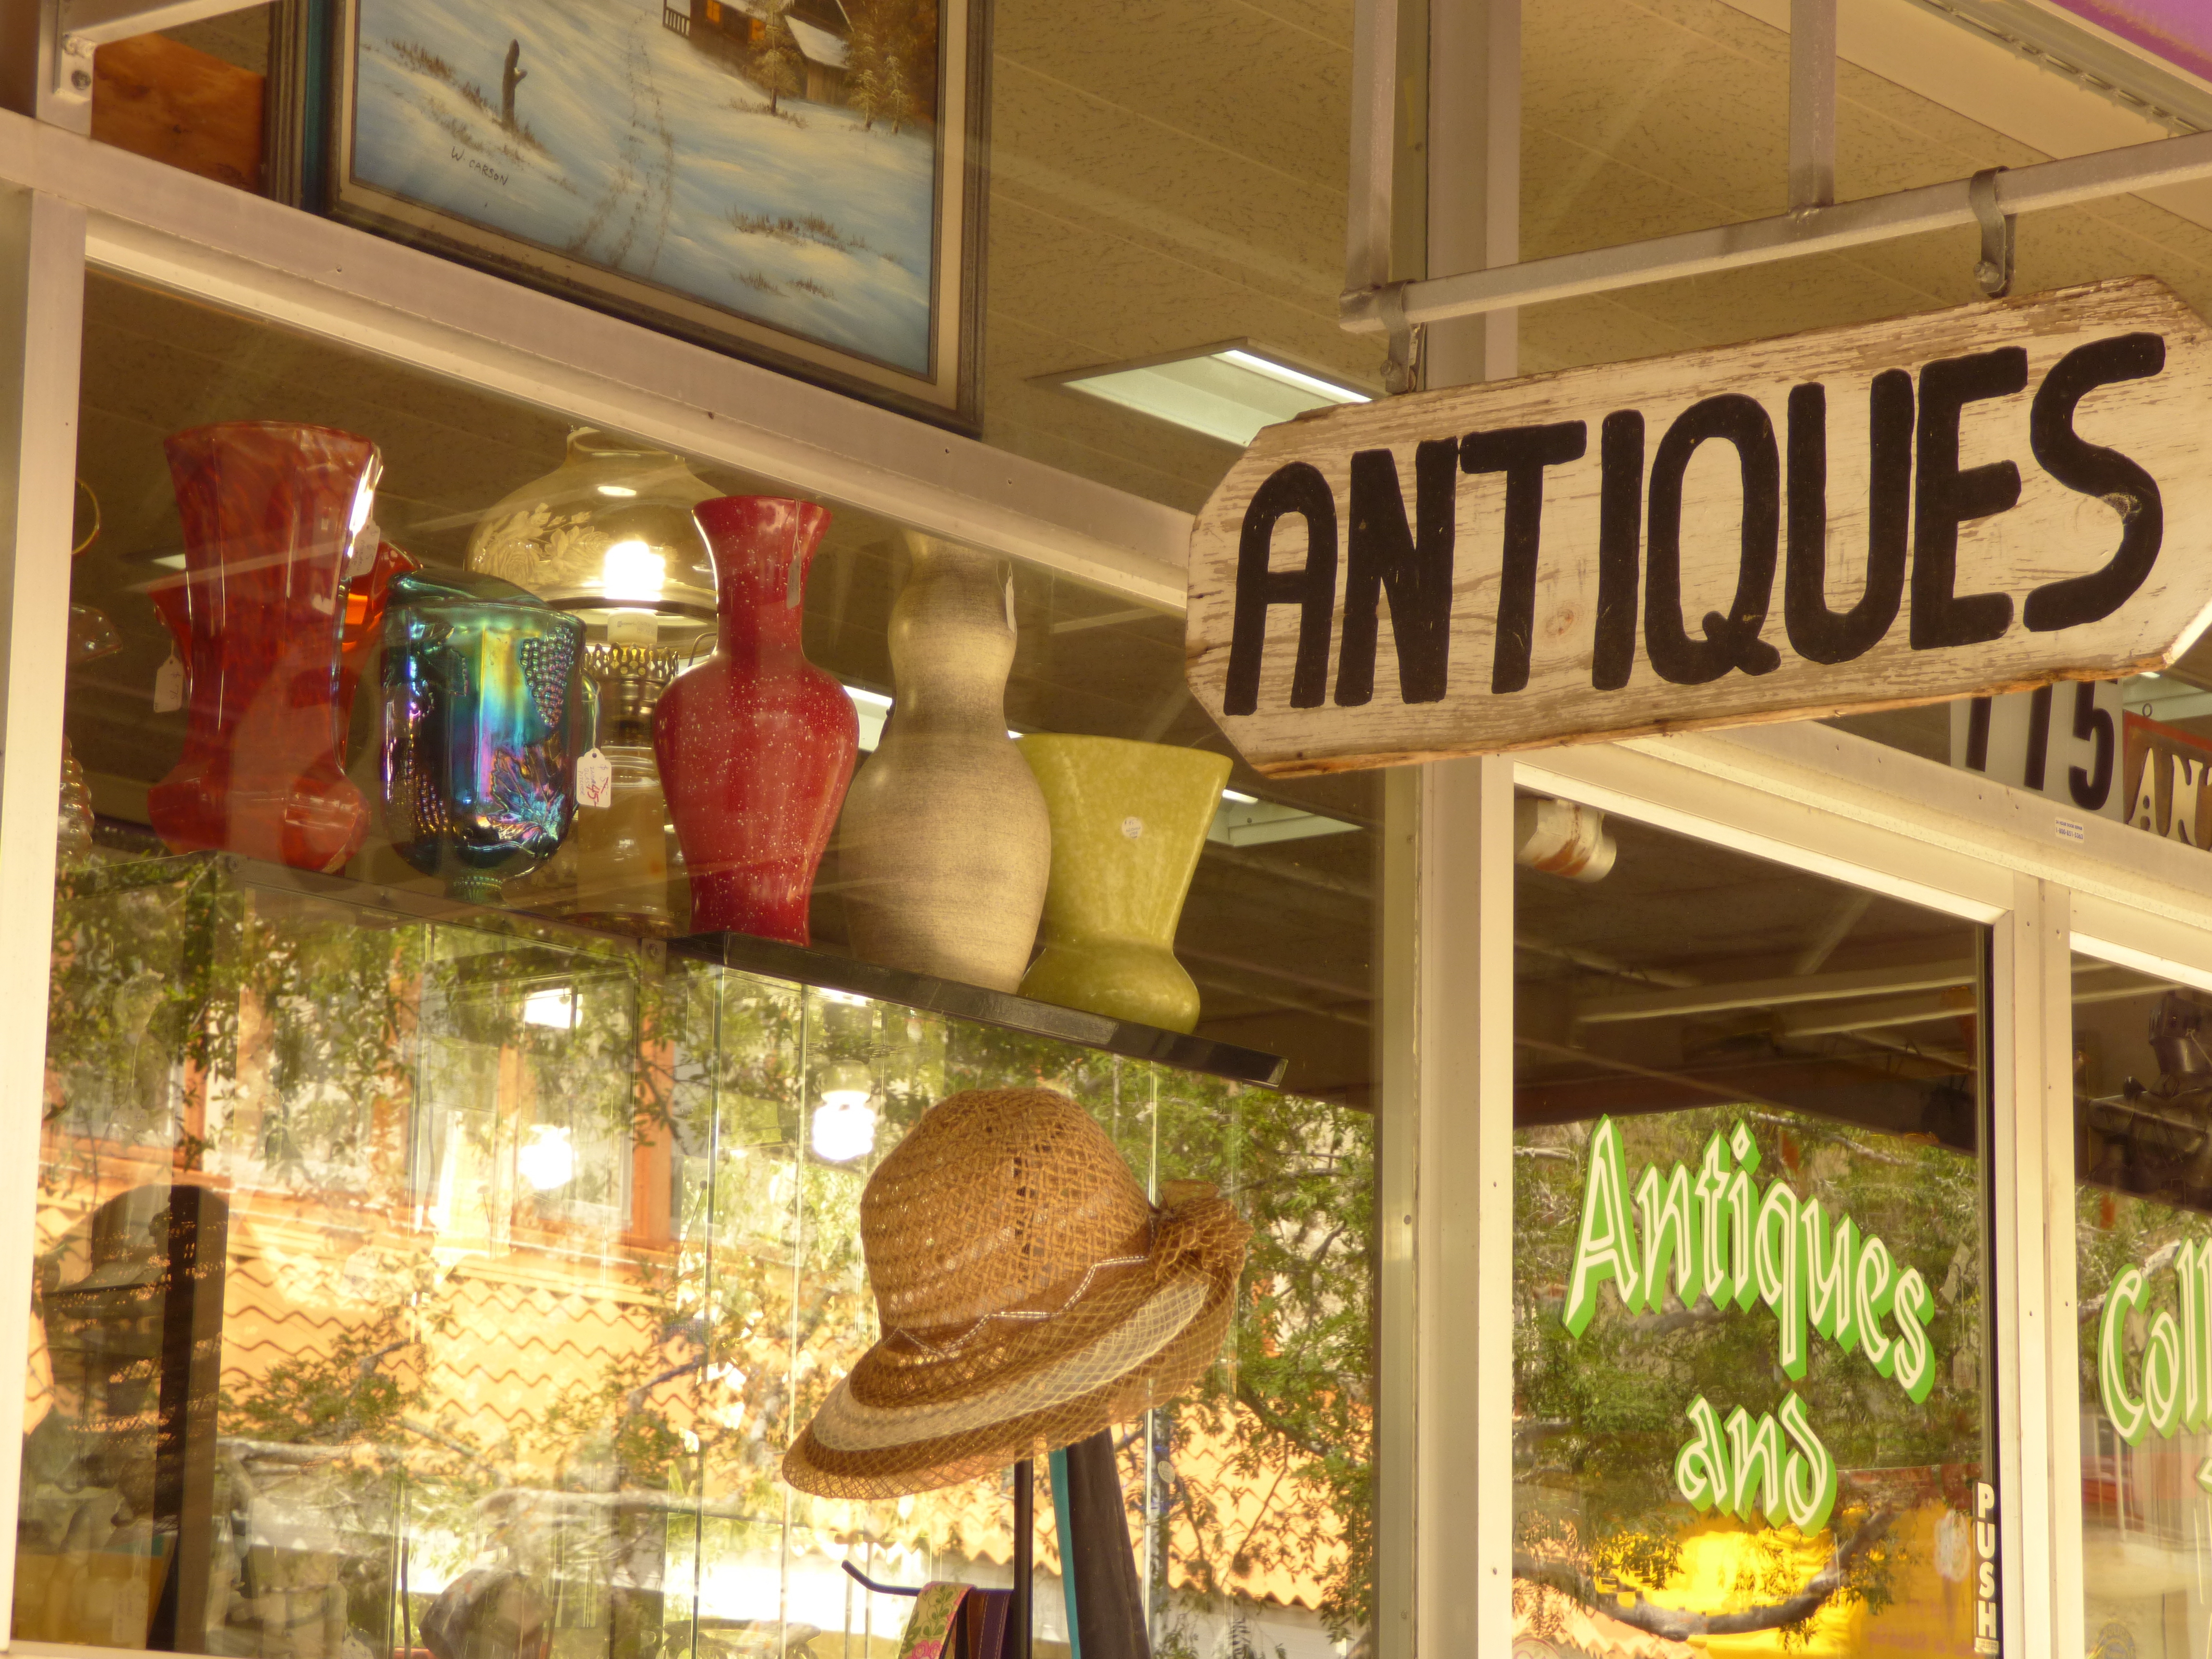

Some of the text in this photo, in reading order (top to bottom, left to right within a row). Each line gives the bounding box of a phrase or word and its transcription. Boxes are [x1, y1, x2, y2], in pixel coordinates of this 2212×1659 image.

[469, 159, 508, 185] CARSON
[1223, 333, 2165, 715] ANTIQUES
[2126, 747, 2212, 848] AN
[1562, 1114, 1935, 1404] Antiques
[1674, 1388, 1837, 1537] and
[1977, 1483, 1996, 1639] PUSH
